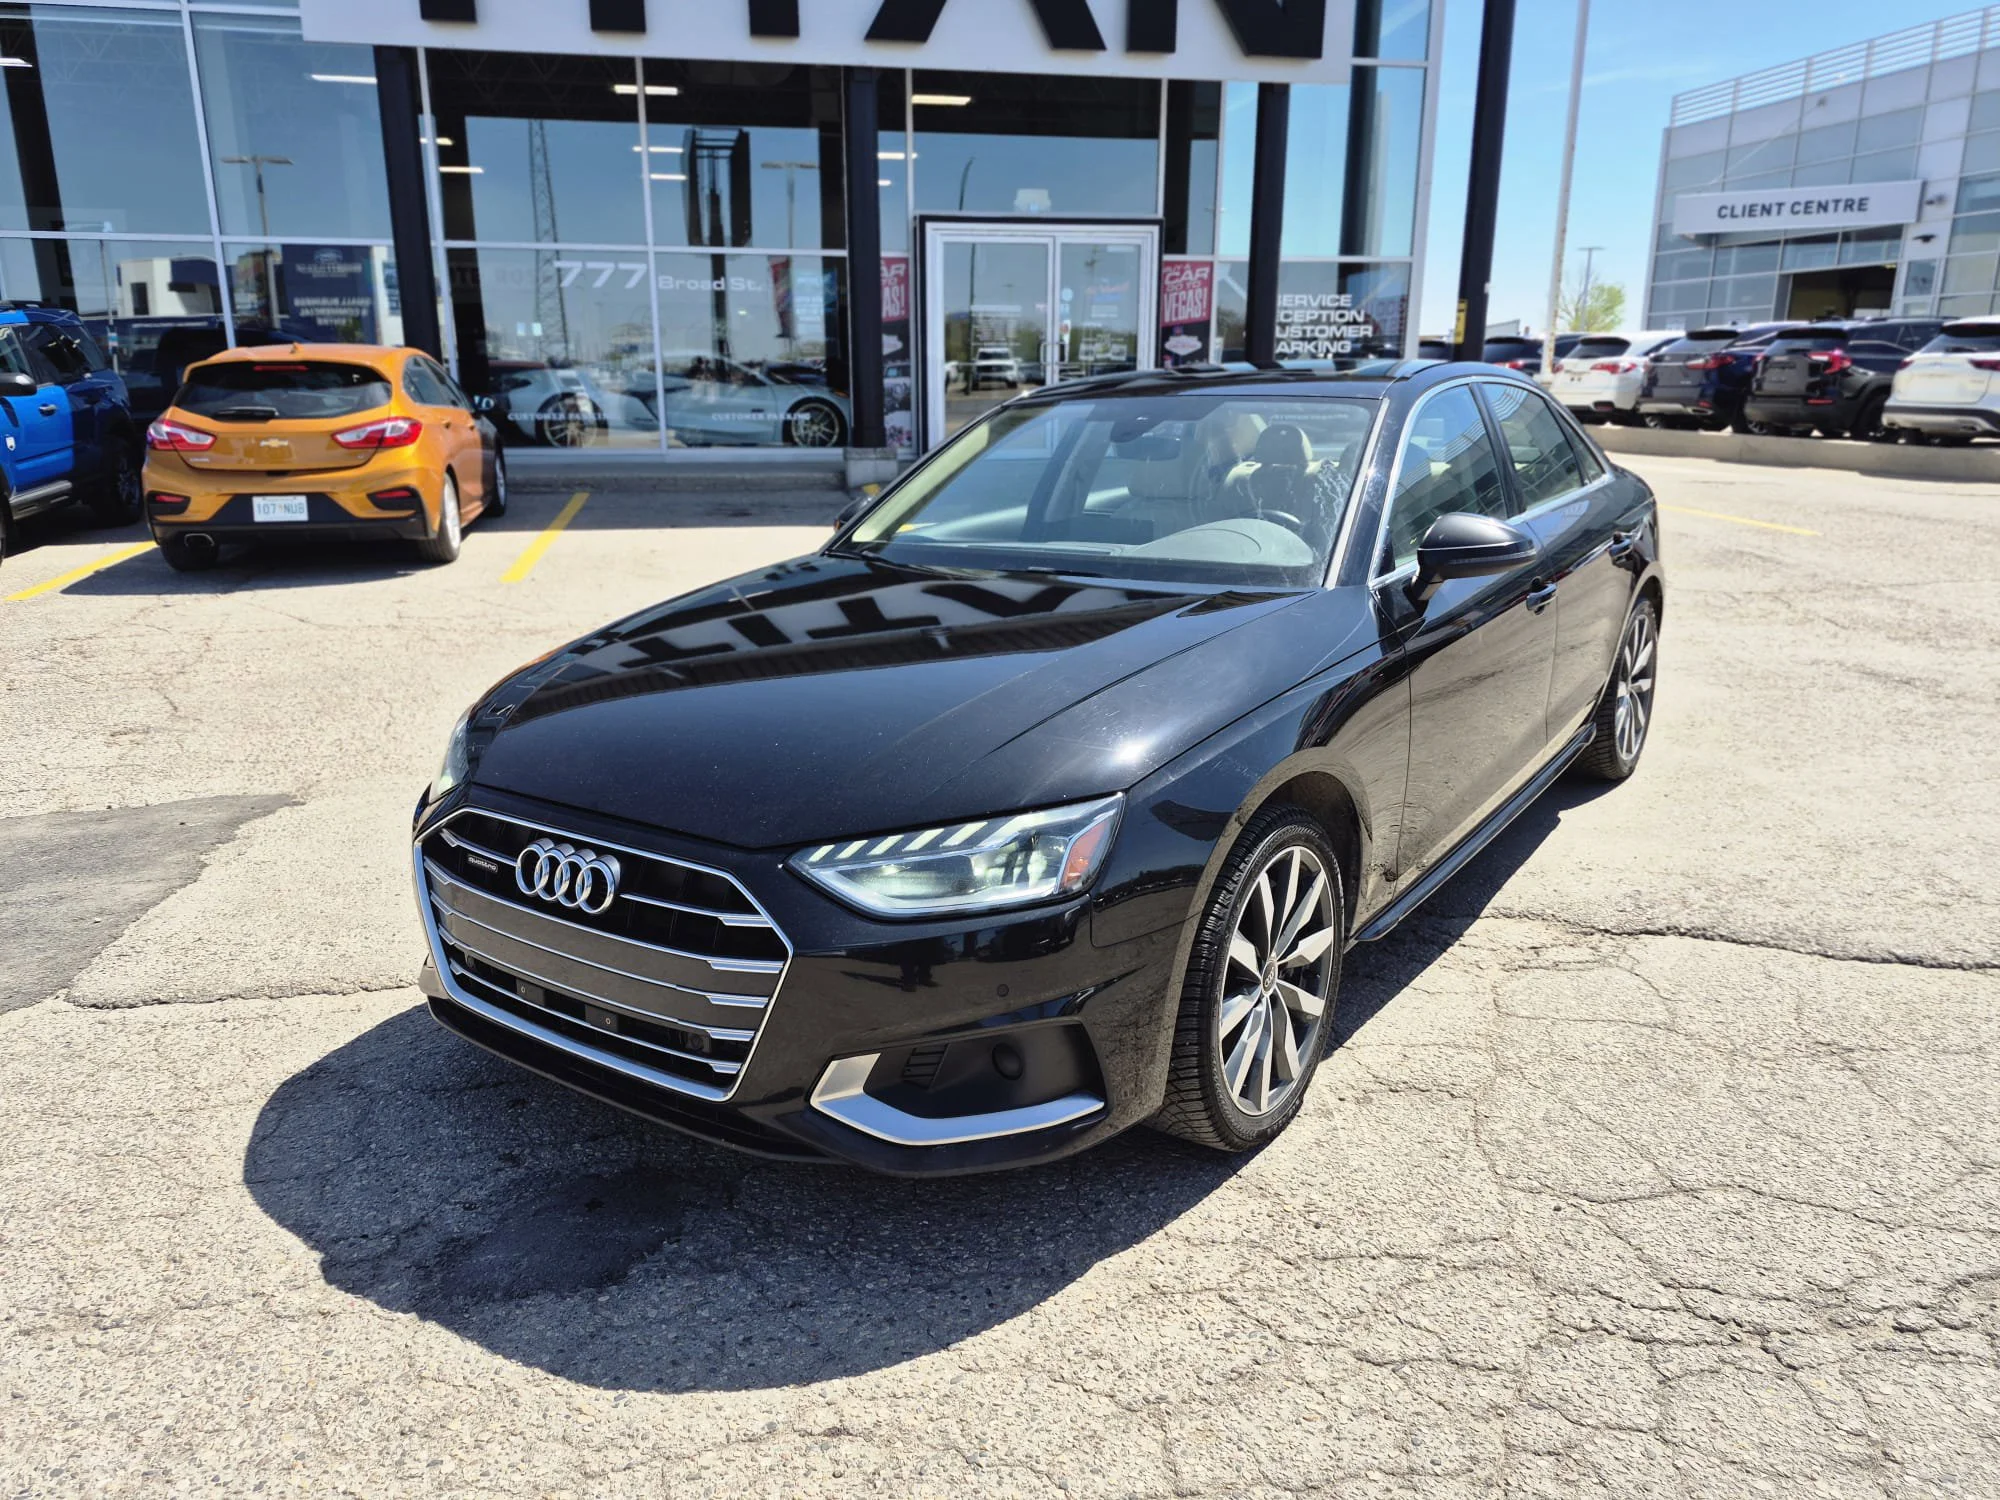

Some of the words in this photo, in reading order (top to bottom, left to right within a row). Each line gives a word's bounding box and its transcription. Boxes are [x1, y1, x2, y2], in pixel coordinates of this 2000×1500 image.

[1717, 202, 1786, 219] CLIENT
[1790, 197, 1870, 215] CENTRE
[553, 260, 647, 290] 777
[658, 276, 725, 291] Broad
[730, 278, 764, 291] St.
[1164, 267, 1210, 285] CAR
[1163, 287, 1208, 323] VEGAS!
[1279, 309, 1365, 323] CEPTION
[1275, 325, 1373, 338] USTOMER
[1274, 341, 1352, 354] ARKING
[711, 412, 762, 421] CUSTOMER
[467, 857, 497, 871] quattro
